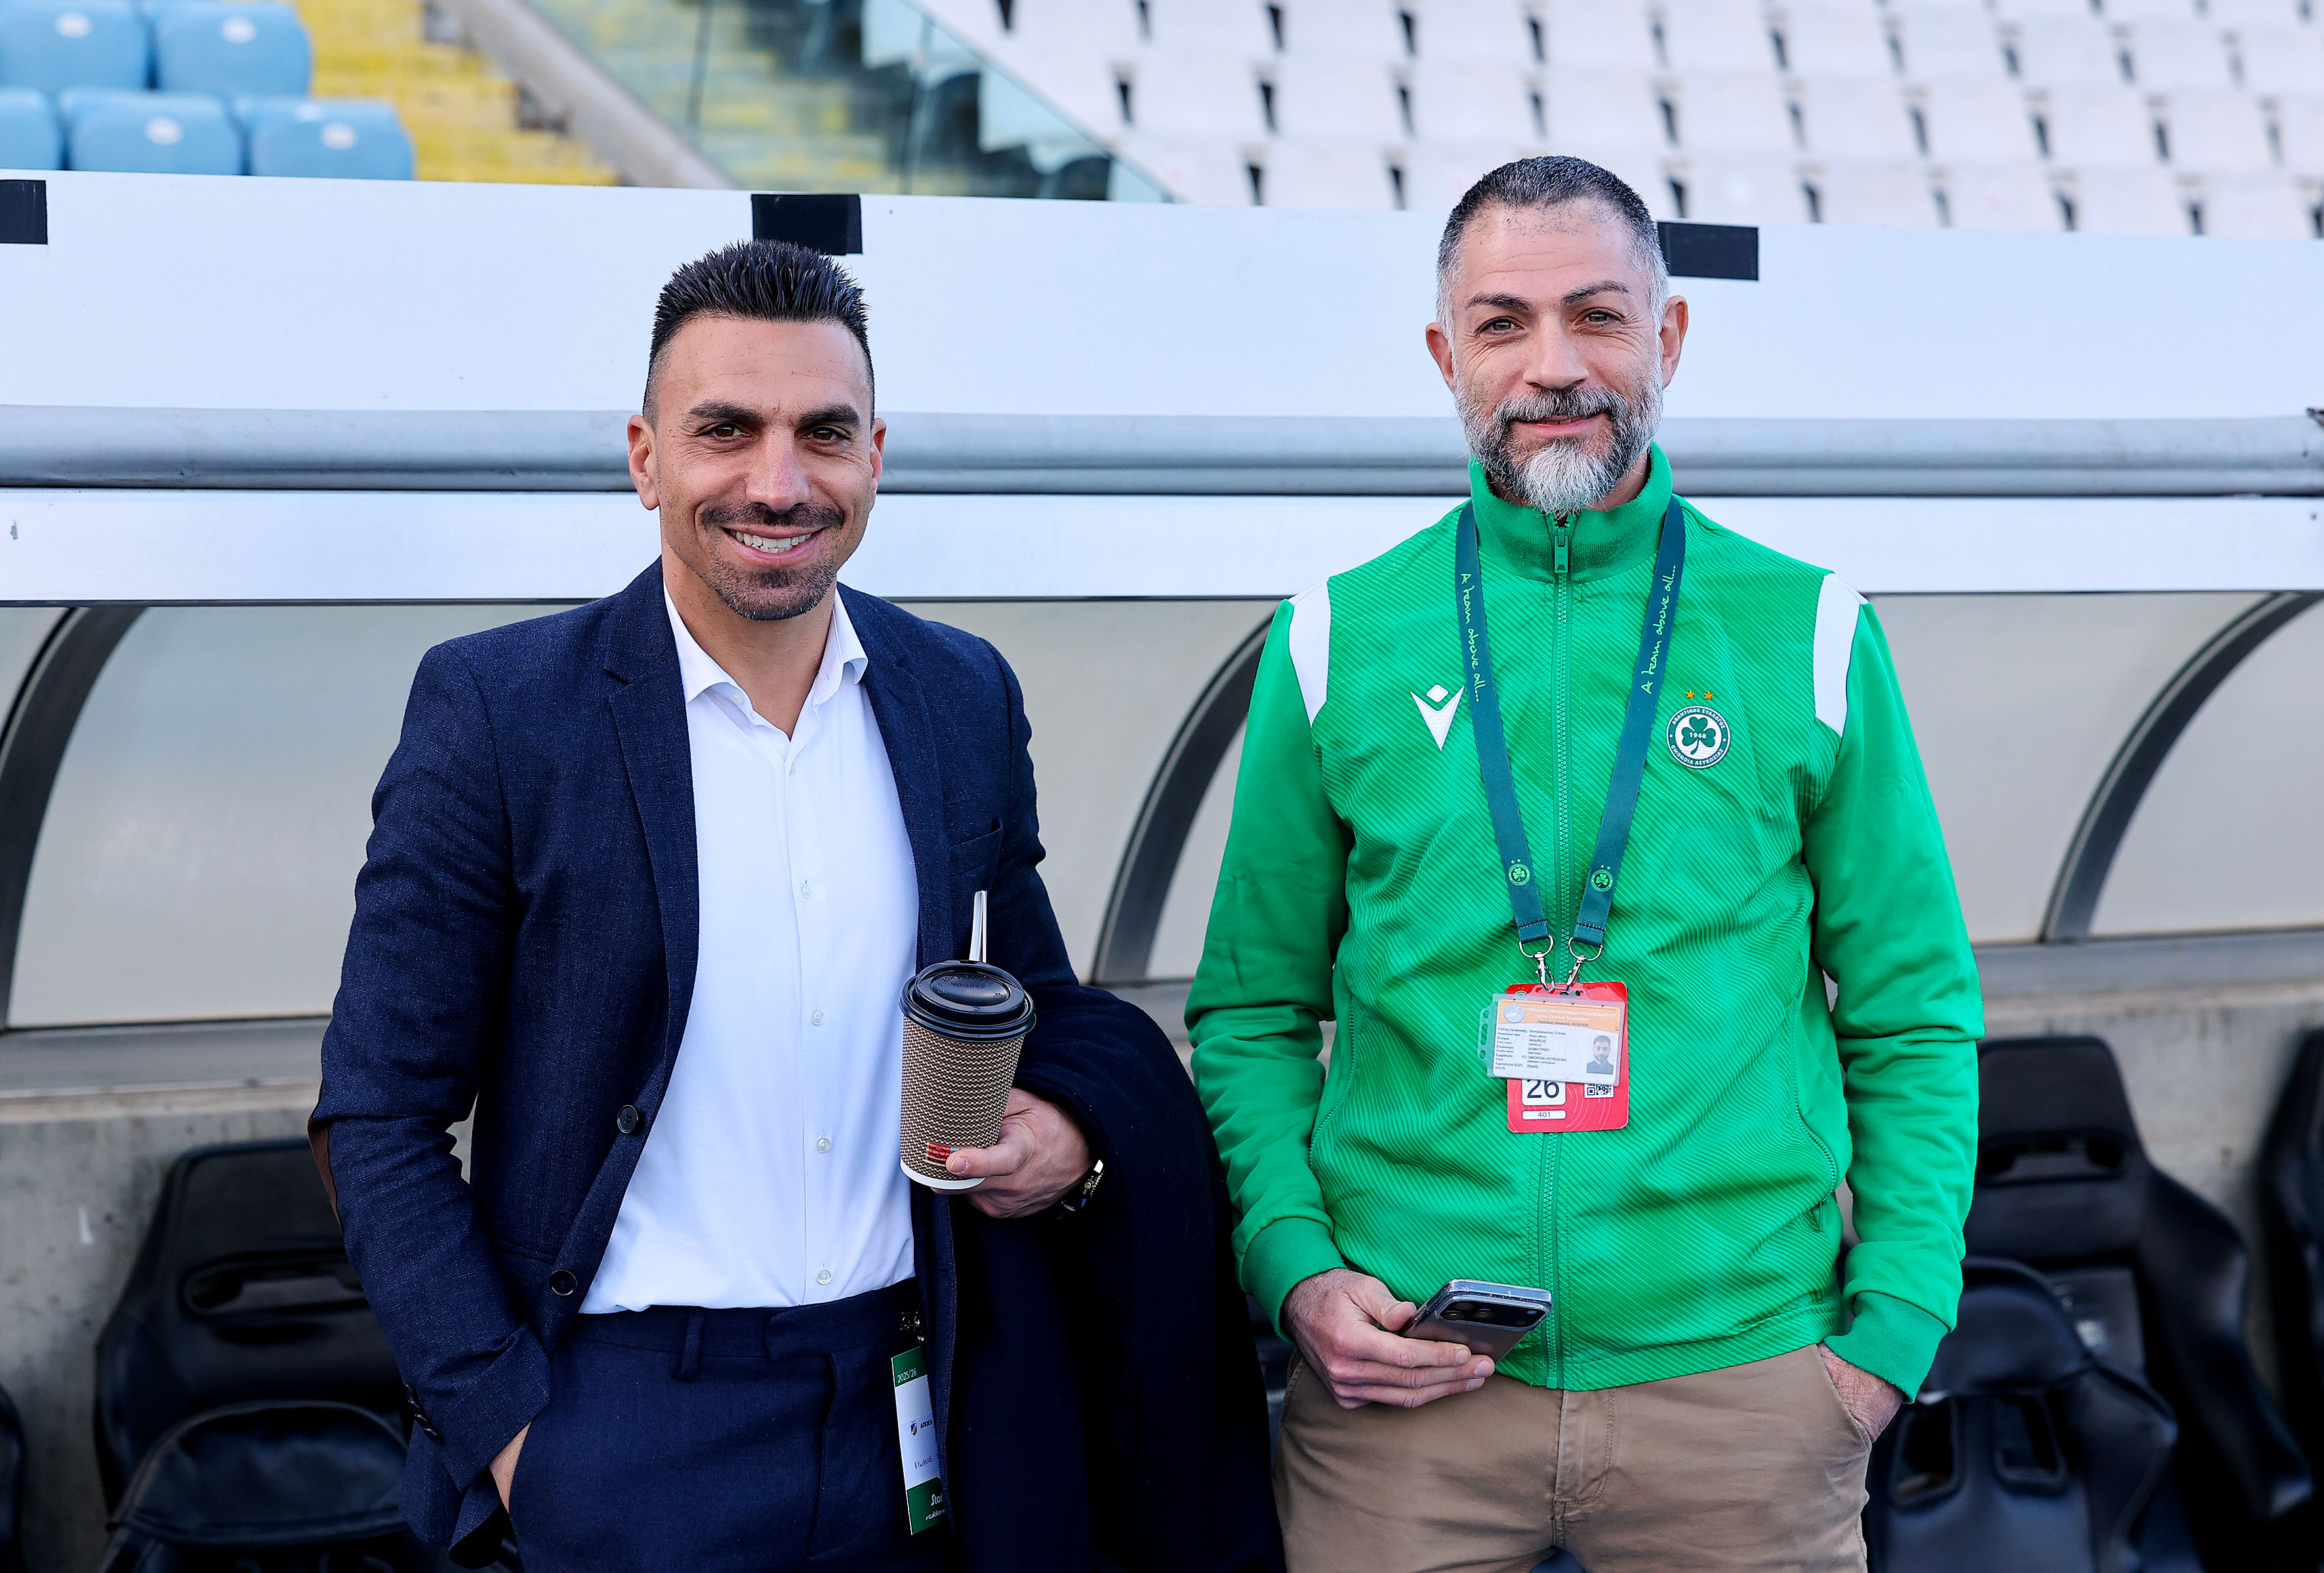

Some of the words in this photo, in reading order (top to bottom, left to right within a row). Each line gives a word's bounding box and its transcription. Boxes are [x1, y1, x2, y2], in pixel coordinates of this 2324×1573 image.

[1461, 573, 1472, 584] A
[1463, 585, 1475, 624] team
[1652, 595, 1669, 636] above
[1467, 628, 1480, 670] above
[1641, 640, 1663, 675] team
[1641, 681, 1654, 695] A
[1702, 709, 1726, 729] ΣΥΛΛΟΓΟΣ
[1671, 745, 1694, 765] ΟΜΟΝΟΙΑ
[1527, 1079, 1560, 1098] 26
[897, 1368, 918, 1383] 2025/26
[931, 1493, 944, 1506] Stoi
